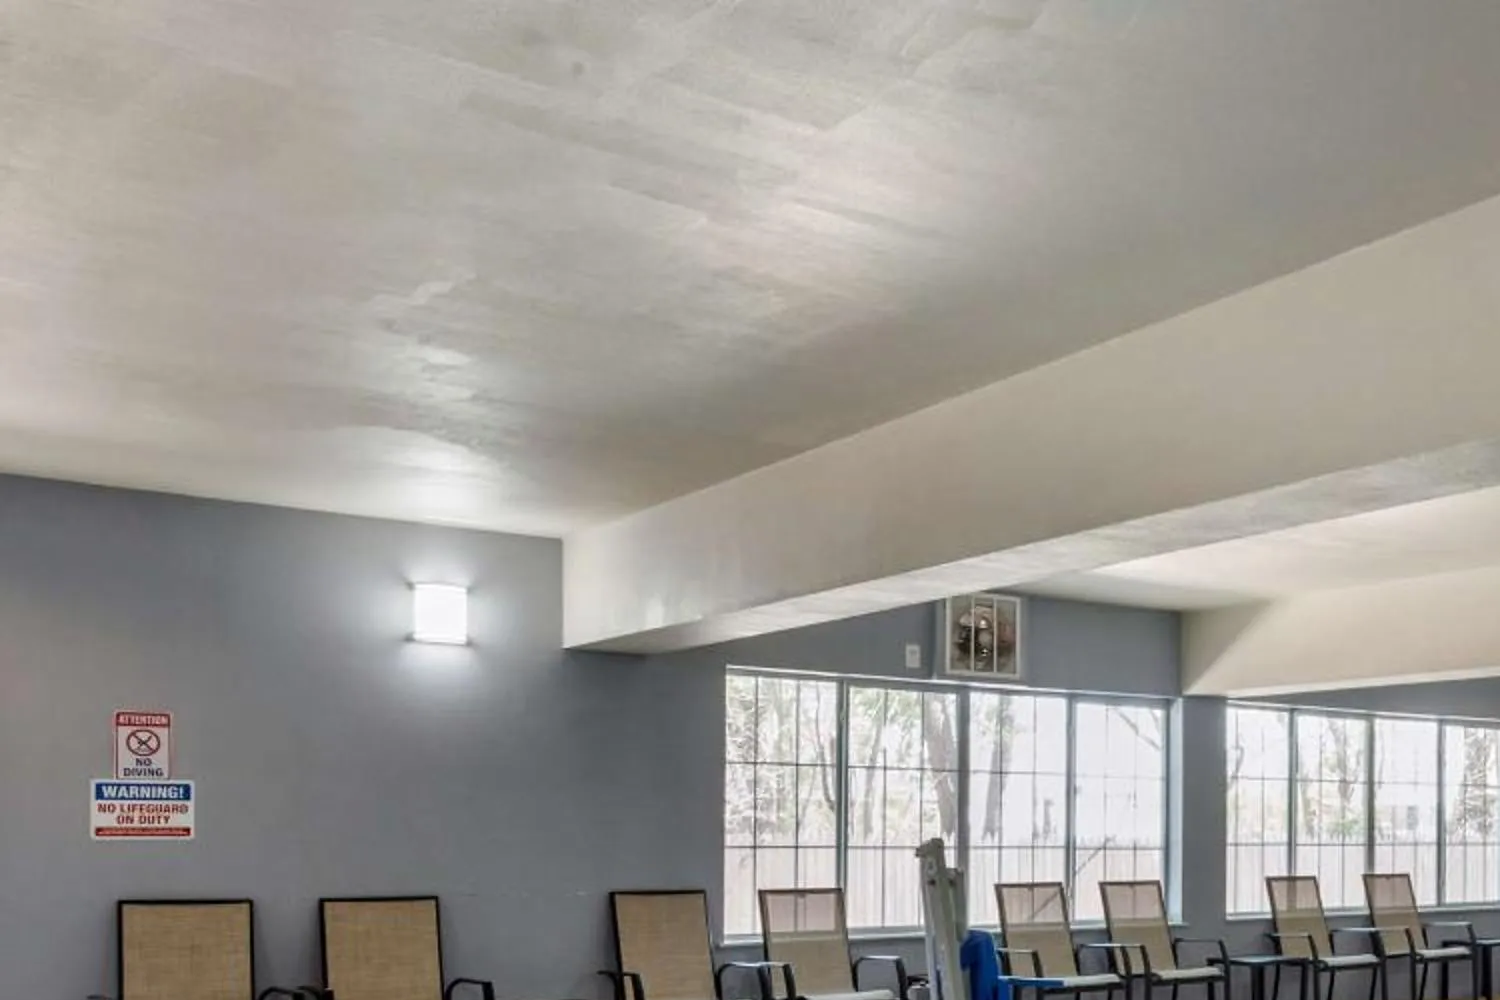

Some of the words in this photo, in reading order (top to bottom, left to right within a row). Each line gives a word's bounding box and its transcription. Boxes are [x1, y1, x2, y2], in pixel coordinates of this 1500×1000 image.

[136, 758, 152, 766] NO
[123, 767, 164, 777] DIVING
[102, 785, 184, 798] WARNING!
[97, 803, 116, 813] NO
[120, 803, 189, 814] LIFEGUARD
[117, 815, 134, 824] ON
[138, 815, 171, 824] DUTY
